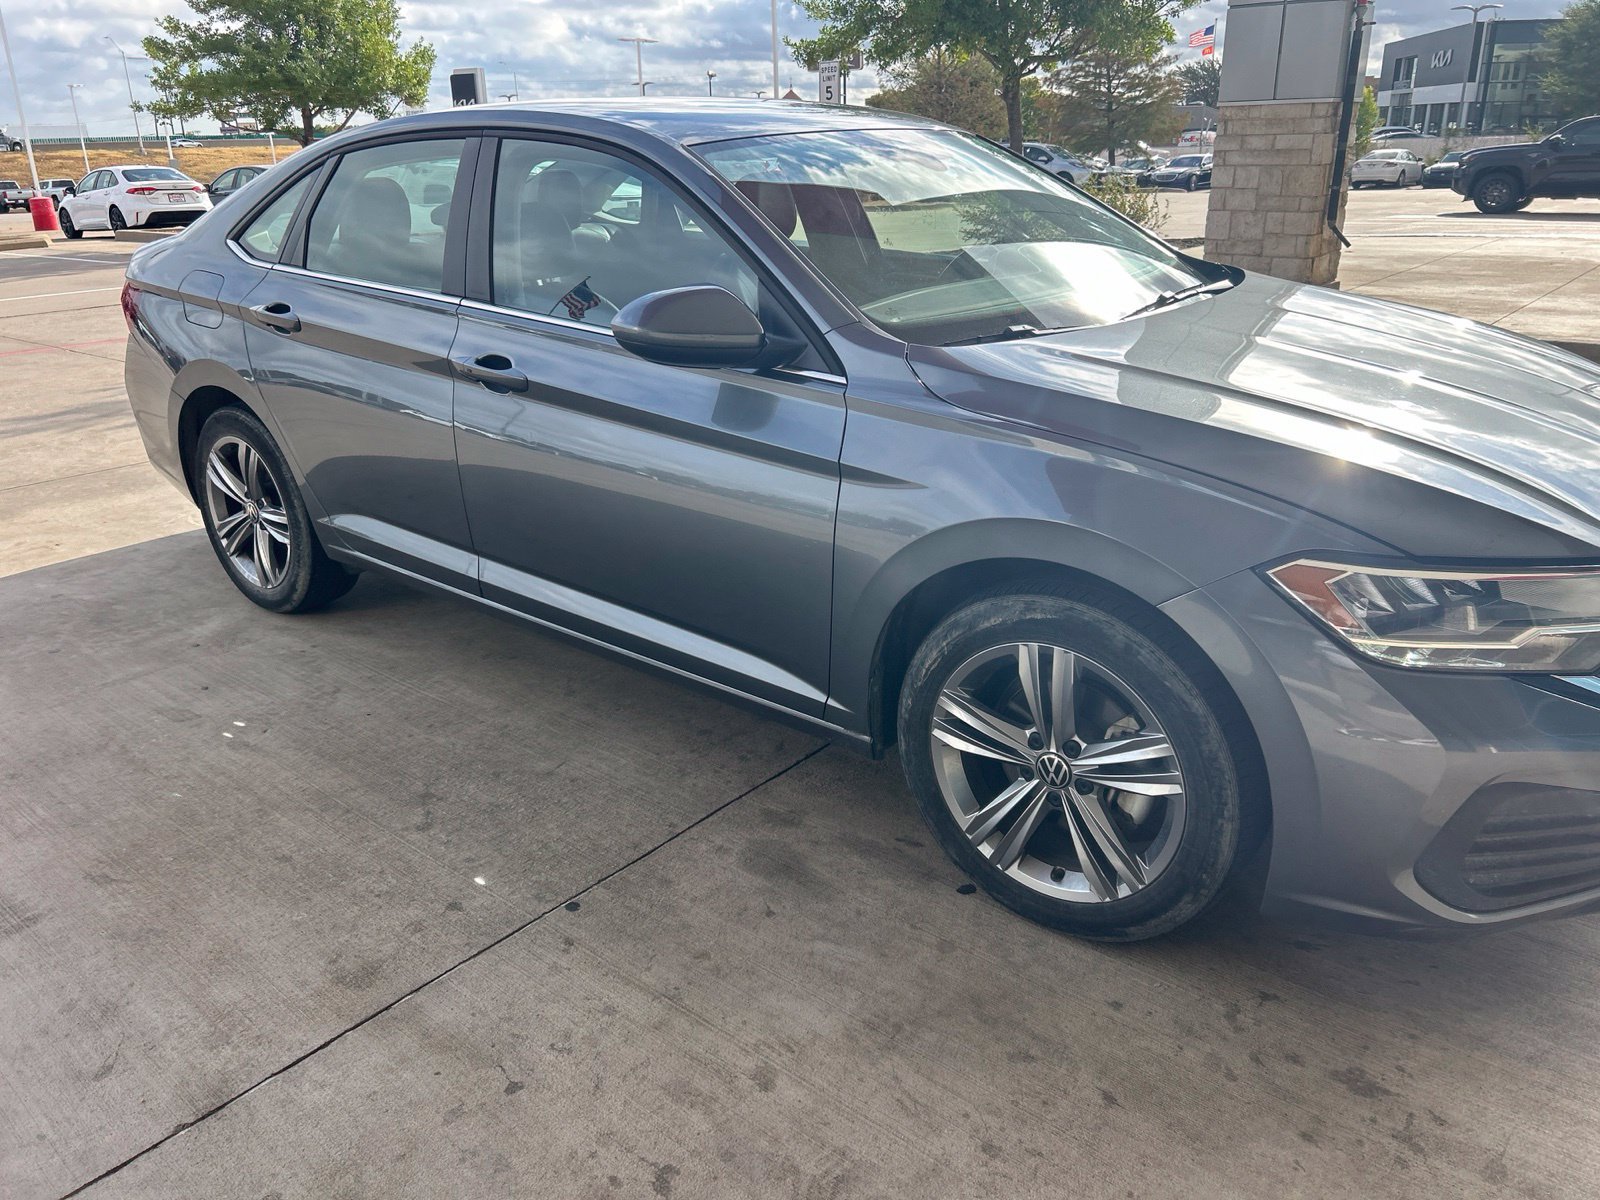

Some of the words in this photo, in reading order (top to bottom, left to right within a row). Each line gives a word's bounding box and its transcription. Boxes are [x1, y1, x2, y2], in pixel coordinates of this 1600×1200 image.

[1431, 48, 1452, 68] KIA
[821, 65, 837, 73] SPEED
[826, 86, 833, 100] 5
